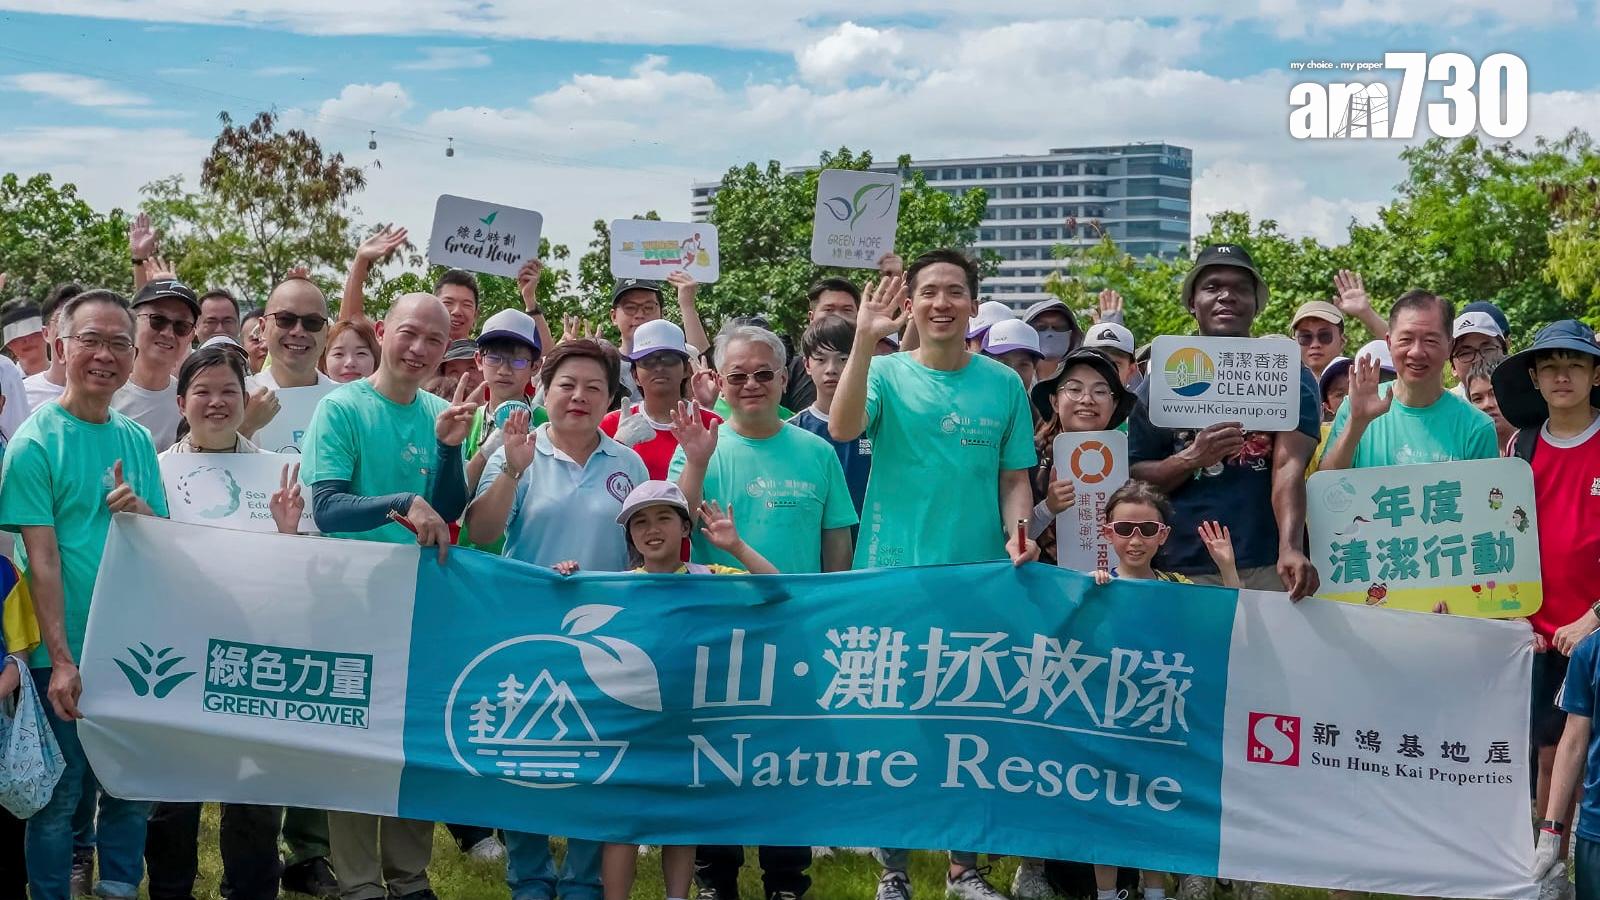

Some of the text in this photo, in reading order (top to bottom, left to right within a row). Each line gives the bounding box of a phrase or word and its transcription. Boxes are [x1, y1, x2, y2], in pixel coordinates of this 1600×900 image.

[444, 235, 521, 264] Green Hour
[827, 234, 881, 248] GREEN HOPE
[1217, 352, 1289, 369] 清潔香港
[1217, 370, 1288, 382] HONG KONG
[1217, 382, 1288, 397] CLEANUP
[1162, 403, 1287, 419] www.HKcleanup.org
[245, 490, 266, 500] Sea
[1371, 480, 1464, 527] 年度
[1329, 530, 1516, 584] 清潔行動
[207, 643, 369, 700] 綠色力量
[204, 693, 366, 727] GREEN POWER
[1312, 722, 1512, 764] 新鴻基地產
[688, 734, 1183, 812] Nature Rescue
[1311, 752, 1513, 786] Sun Hung Kai Properties
